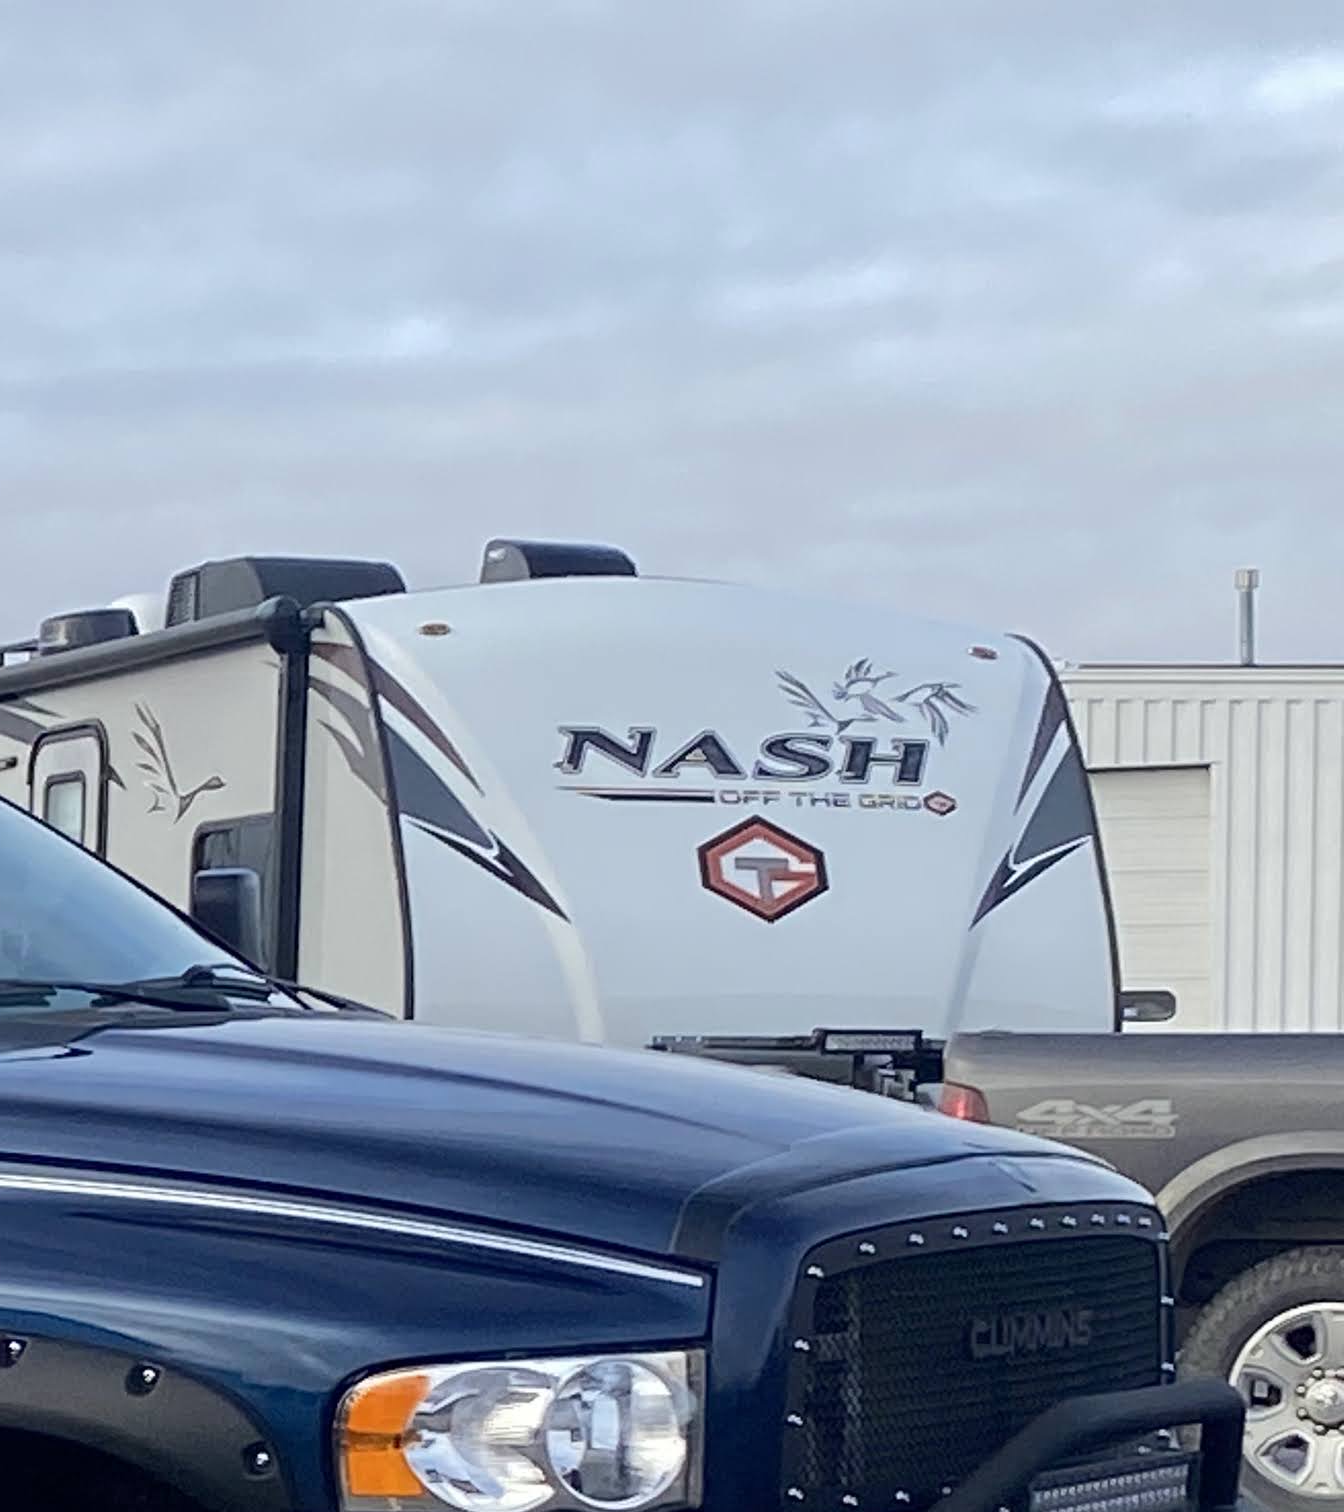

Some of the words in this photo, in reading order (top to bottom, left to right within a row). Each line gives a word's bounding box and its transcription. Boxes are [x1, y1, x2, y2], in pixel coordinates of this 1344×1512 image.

[555, 725, 930, 786] NASH
[720, 790, 781, 806] OFF
[788, 792, 851, 808] THE
[858, 794, 921, 811] GRID
